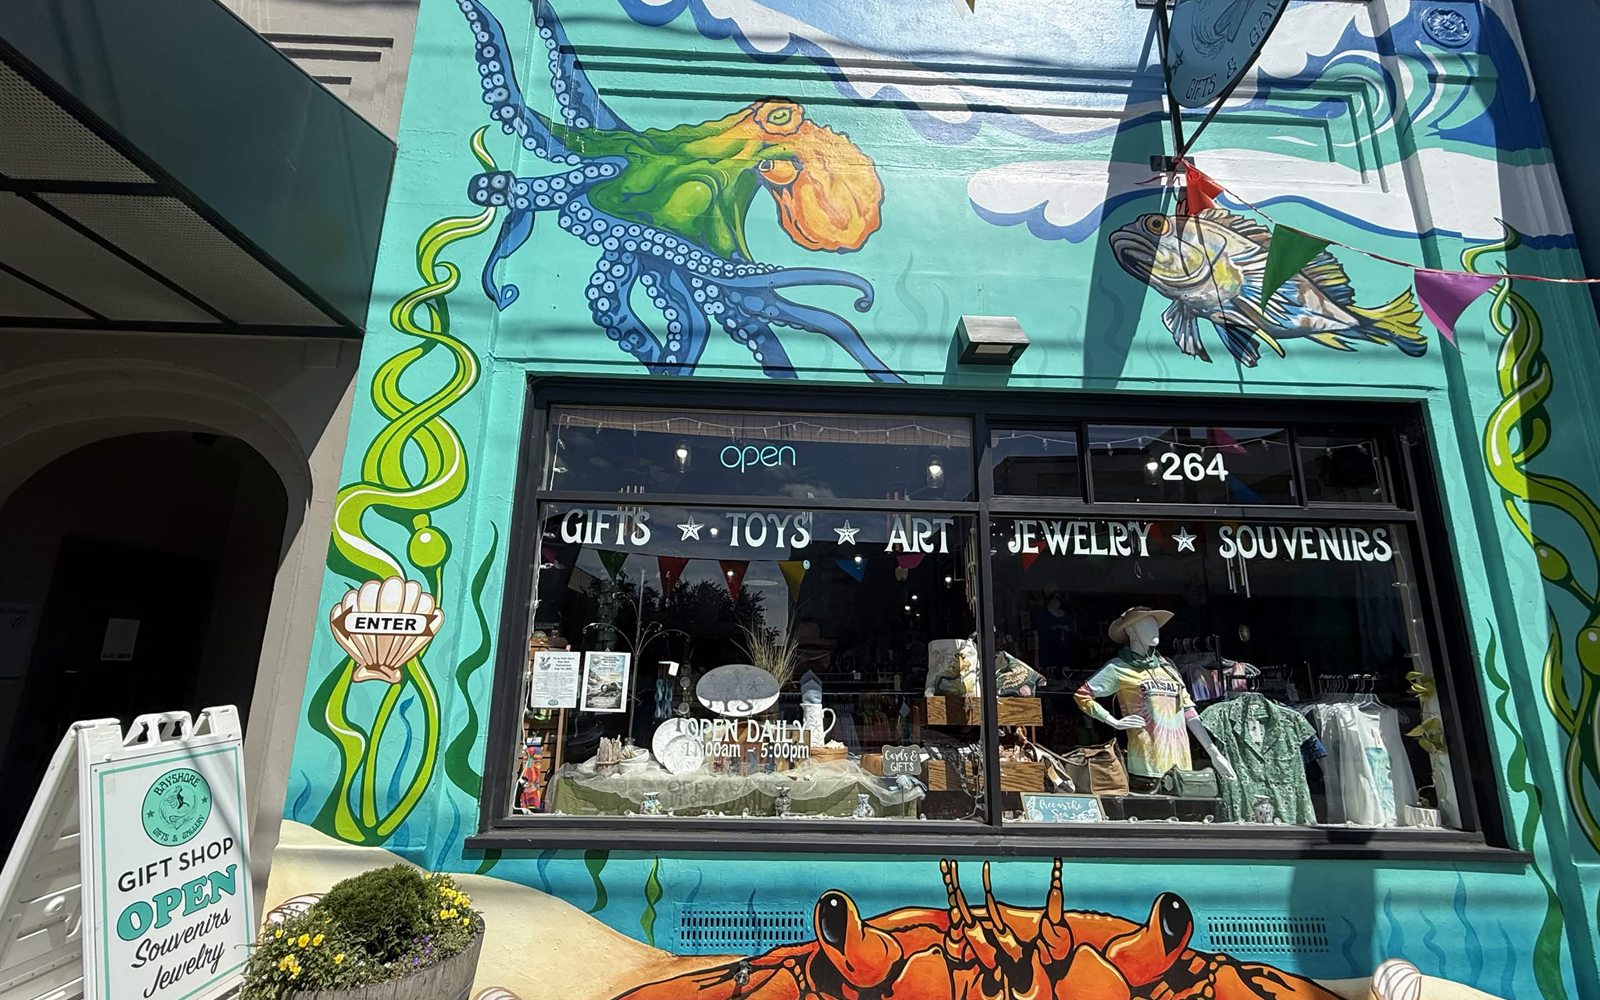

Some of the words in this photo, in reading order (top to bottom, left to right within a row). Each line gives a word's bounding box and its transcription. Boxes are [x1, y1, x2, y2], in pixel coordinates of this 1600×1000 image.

[1185, 73, 1217, 100] GIFTS
[719, 445, 796, 473] open
[1160, 452, 1229, 482] 264
[560, 508, 652, 546] GIFTS
[725, 511, 810, 549] TOYS
[885, 517, 954, 554] ART
[1008, 519, 1151, 558] JEWELRY
[1218, 525, 1393, 562] SOUVENIRS
[354, 616, 417, 631] ENTER
[687, 717, 738, 742] OPEN
[746, 718, 809, 743] DAILY
[761, 742, 810, 762] 5:00pm
[910, 750, 918, 762] &
[890, 761, 914, 772] GIFTS
[153, 772, 201, 796] BAYSHORE
[152, 827, 170, 842] GIFTS
[181, 814, 205, 840] GALLERY
[117, 856, 173, 893] GIFT
[178, 836, 234, 871] SHOP
[116, 863, 238, 942] OPEN
[130, 907, 232, 969] Souvenirs
[143, 941, 225, 999] Jewelry
